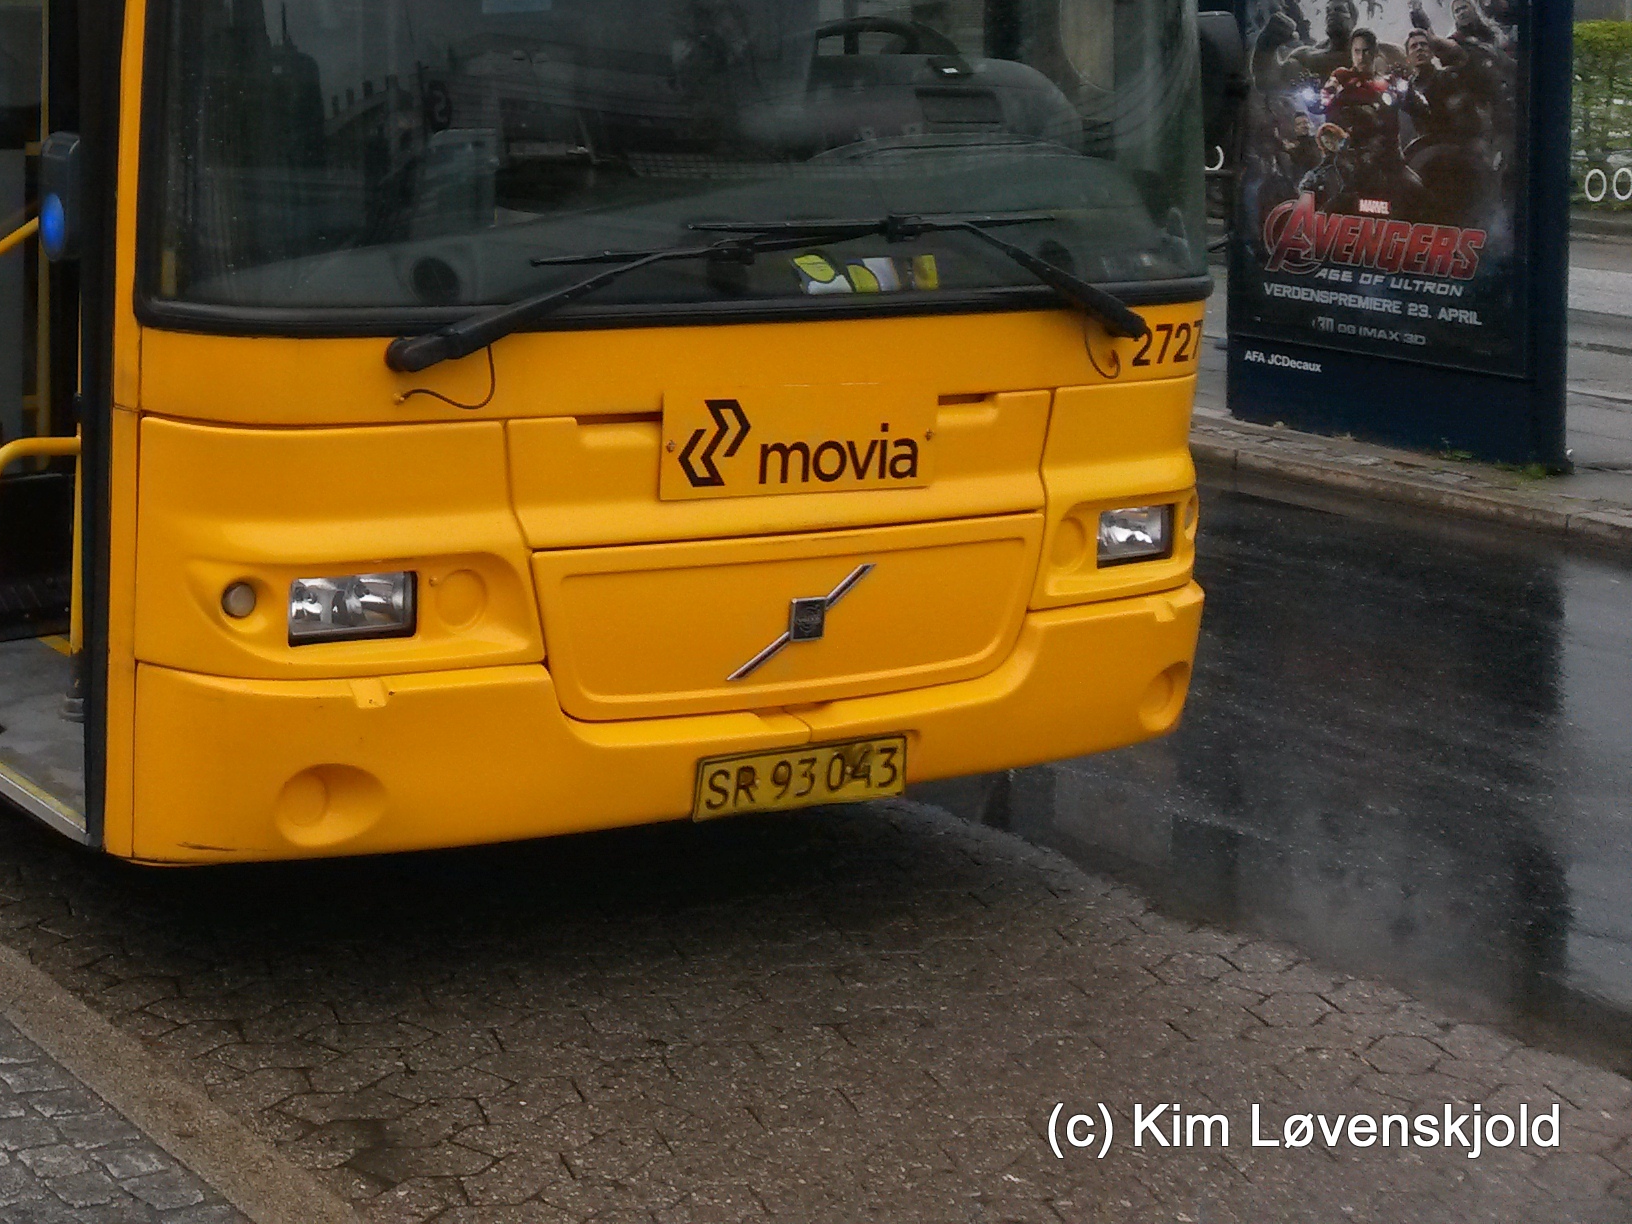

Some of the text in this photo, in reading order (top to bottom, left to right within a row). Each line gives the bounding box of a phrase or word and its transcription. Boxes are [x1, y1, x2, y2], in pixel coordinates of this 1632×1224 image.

[1263, 282, 1483, 326] VERDENSPREMIERE 23. APRIL
[1314, 267, 1465, 297] AGE OF ULTRON
[1132, 319, 1204, 367] 2727
[1358, 327, 1400, 342] IMAX
[1403, 333, 1426, 346] 3D
[1244, 350, 1322, 373] AFA JCDecaux
[758, 423, 919, 485] movia
[705, 747, 898, 811] SR 93 043
